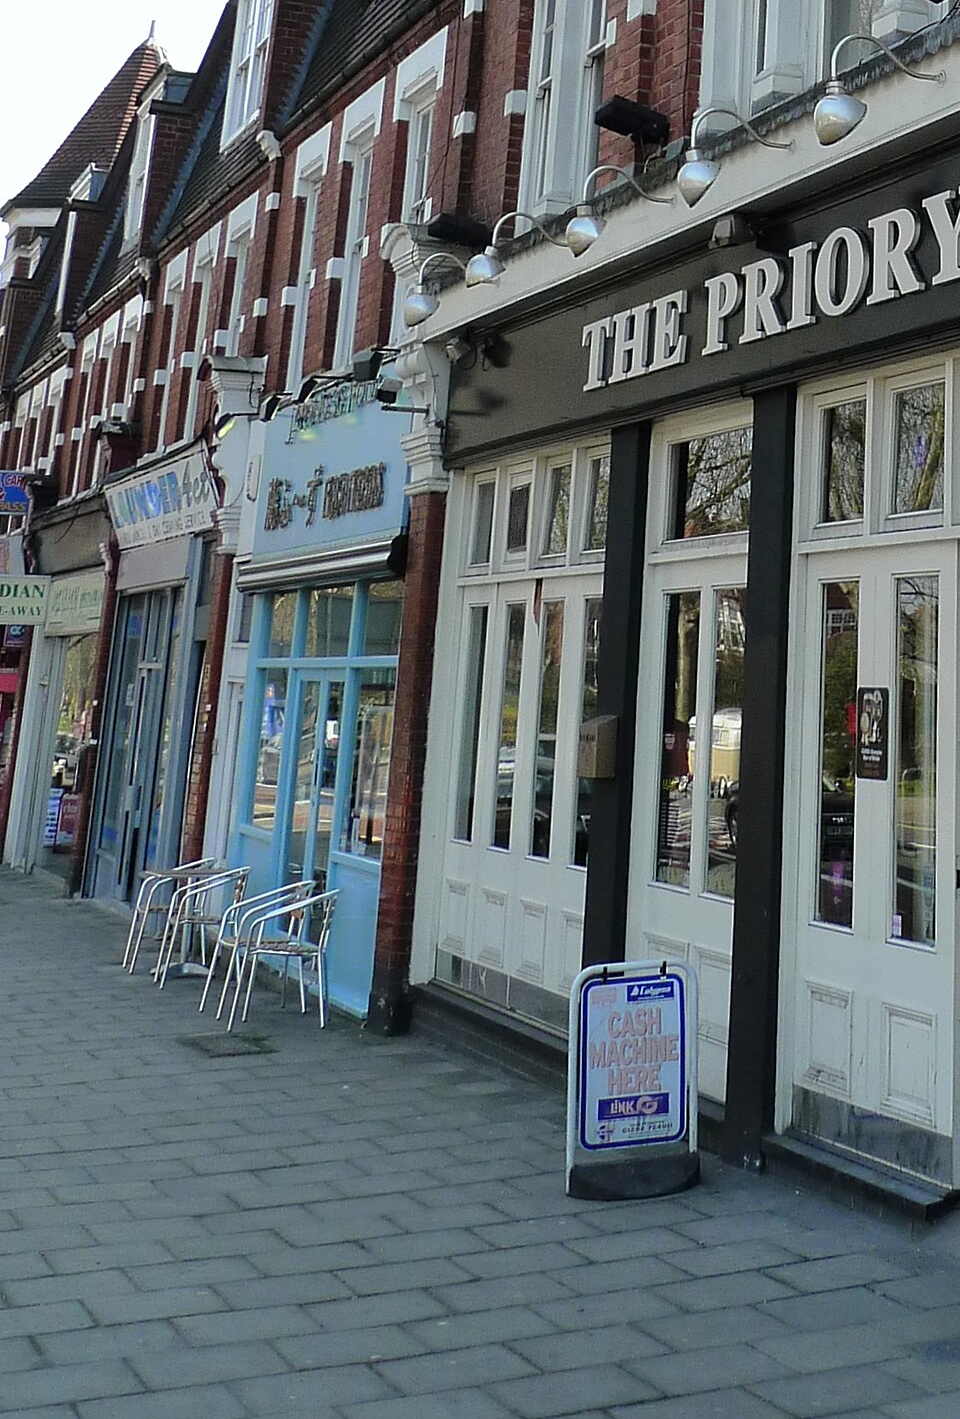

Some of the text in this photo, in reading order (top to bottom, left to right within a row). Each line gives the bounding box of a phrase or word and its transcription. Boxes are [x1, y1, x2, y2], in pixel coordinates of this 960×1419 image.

[582, 289, 688, 392] THE
[608, 1007, 662, 1039] CASH
[590, 1034, 679, 1069] MACHINE
[607, 1064, 661, 1095] HERE
